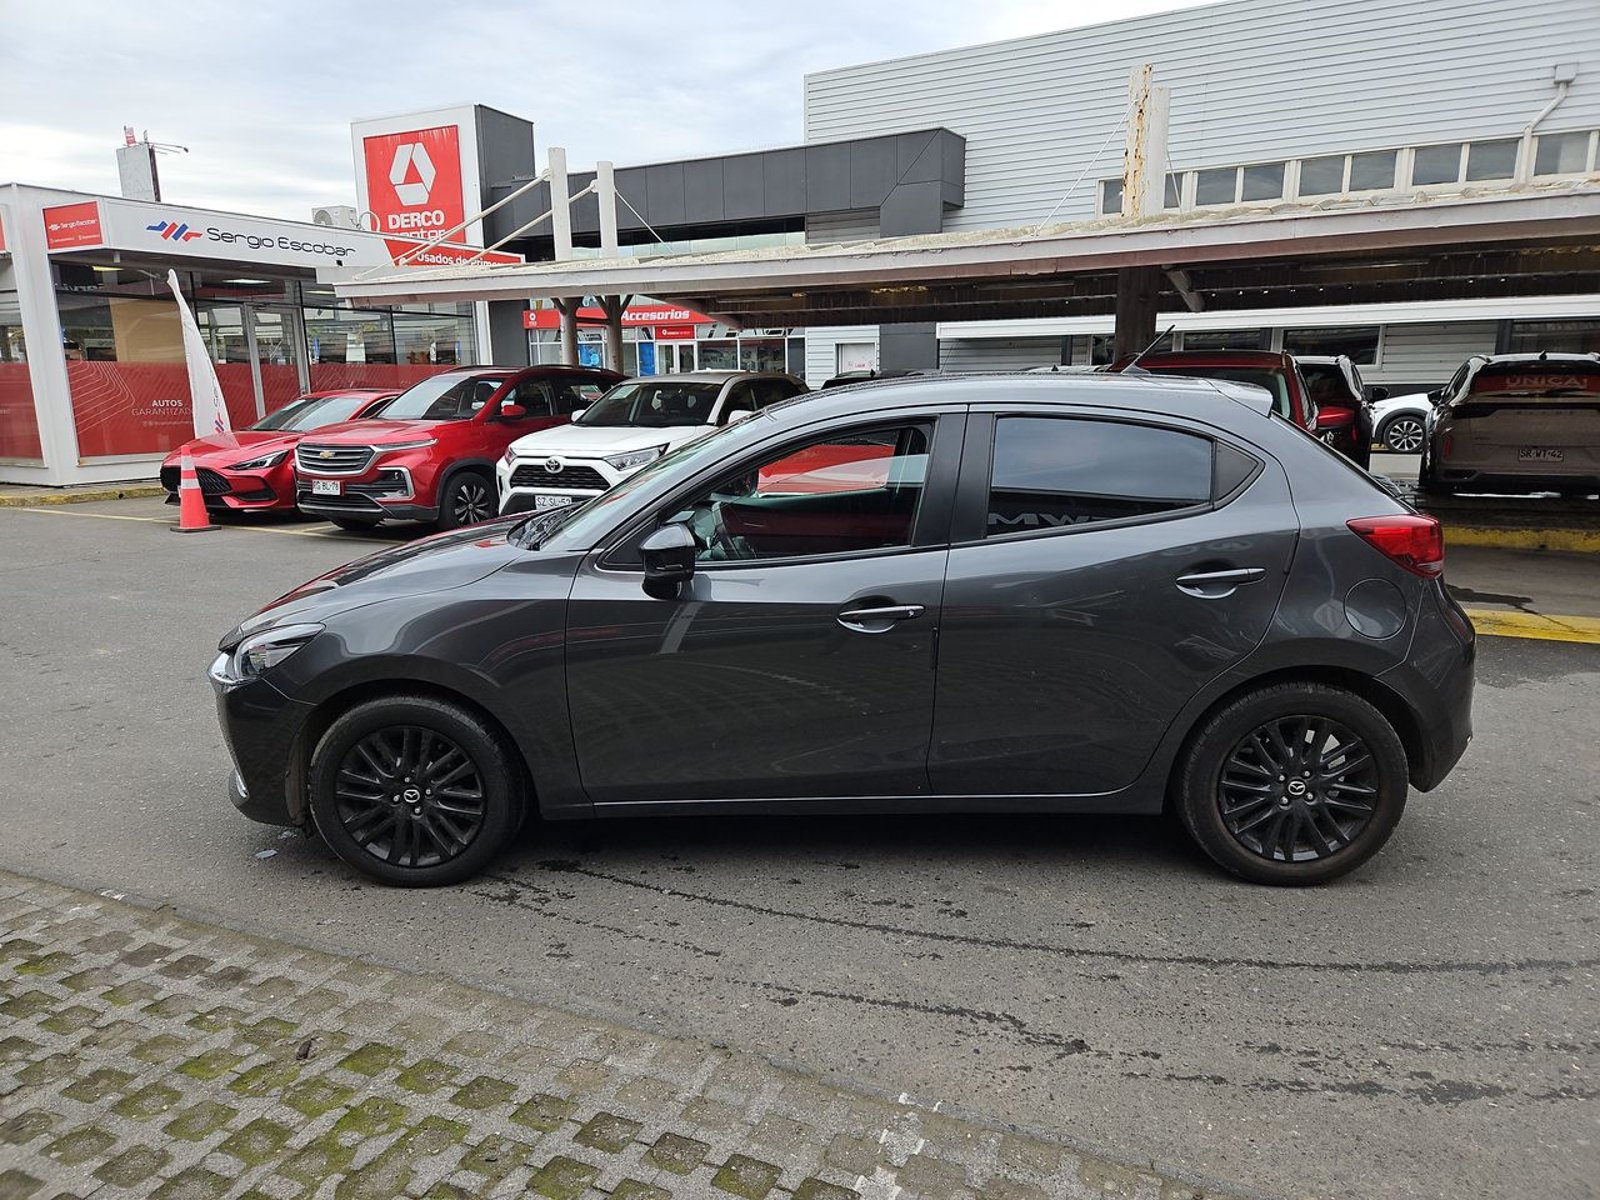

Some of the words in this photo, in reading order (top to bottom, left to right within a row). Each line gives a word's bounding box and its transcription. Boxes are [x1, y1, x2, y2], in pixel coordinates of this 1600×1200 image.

[388, 210, 445, 229] DERCO
[206, 227, 275, 250] Sergio
[278, 236, 355, 256] Escobar
[620, 309, 690, 321] Accesorios
[151, 399, 183, 407] AUTOS
[131, 407, 192, 416] GARANTIZAD
